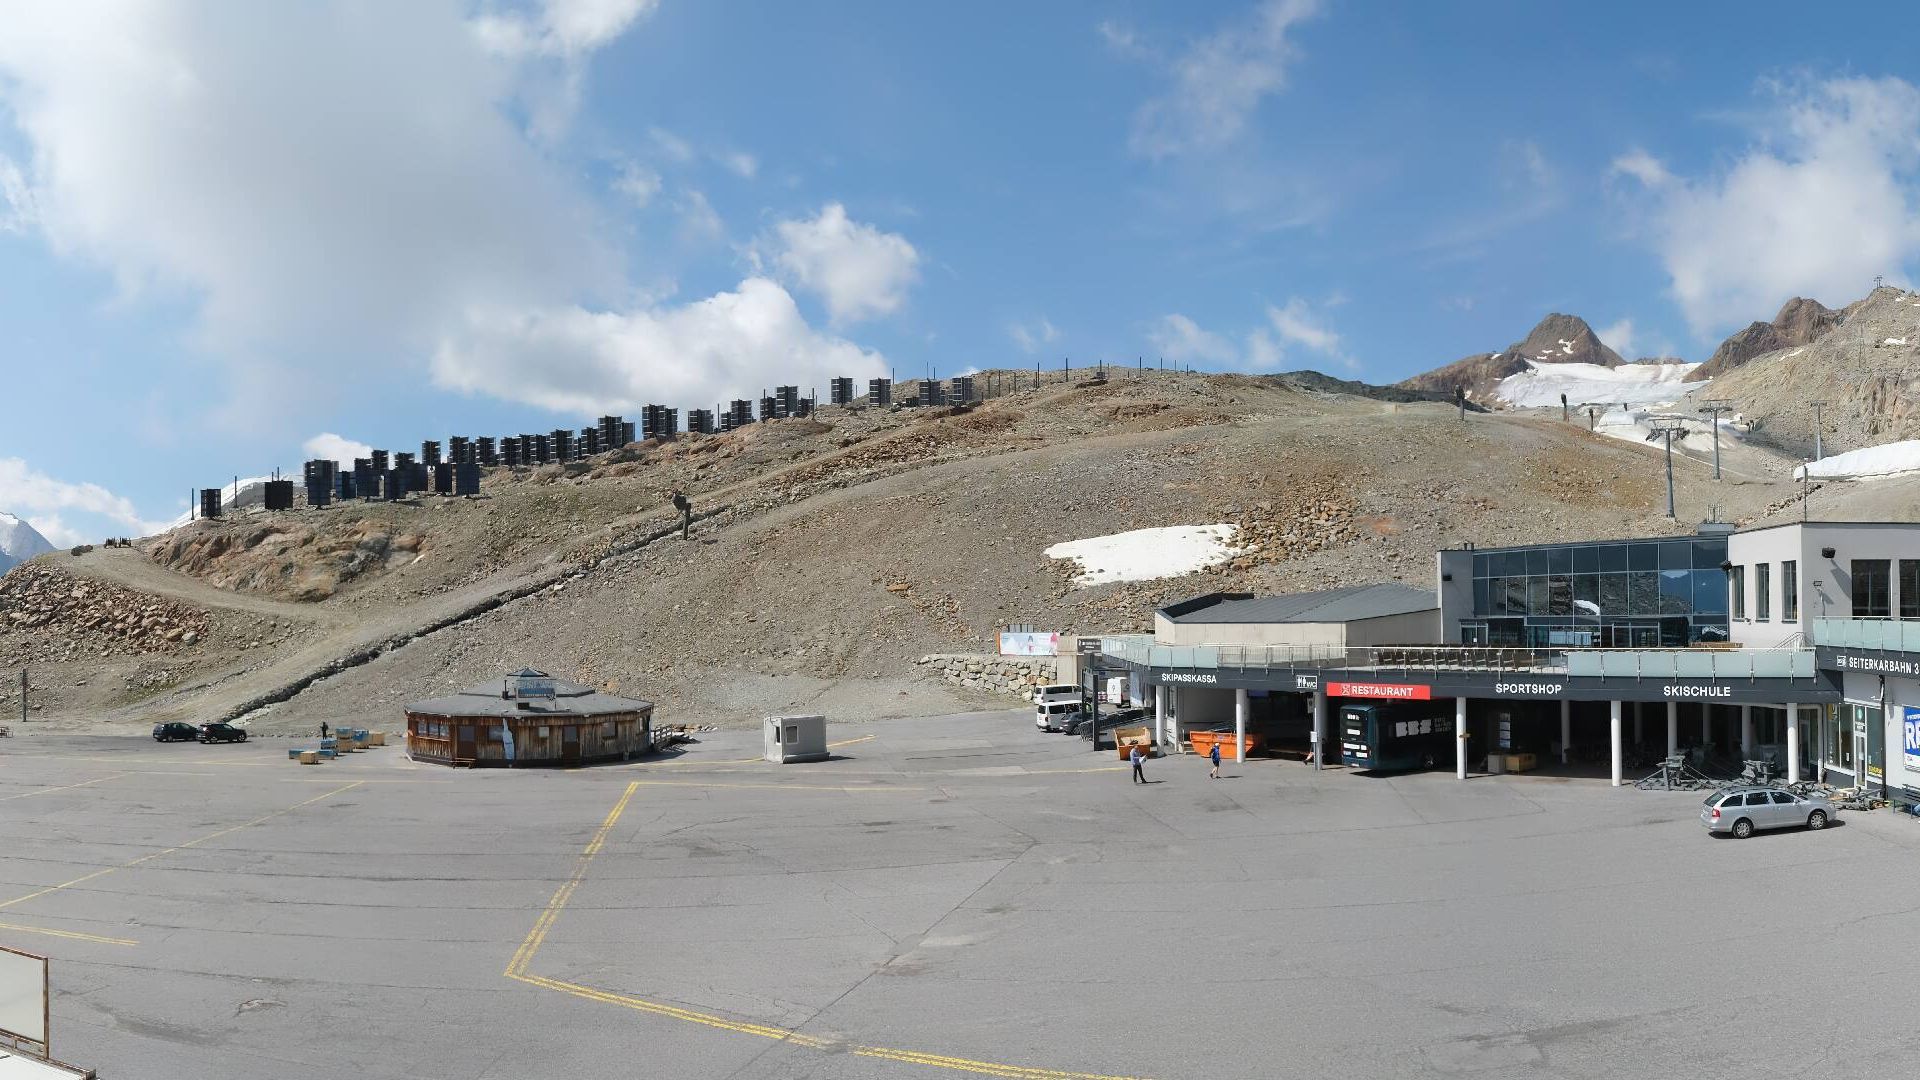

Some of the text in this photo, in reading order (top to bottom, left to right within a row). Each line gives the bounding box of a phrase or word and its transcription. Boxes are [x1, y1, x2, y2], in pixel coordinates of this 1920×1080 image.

[1849, 657, 1920, 675] SEITERKARBAHN 3
[1161, 673, 1217, 683] SKIPASSKASSA
[1351, 685, 1413, 697] RESTAURANT
[1495, 683, 1562, 695] SPORTSHOP
[1663, 686, 1731, 697] SKISCHULE
